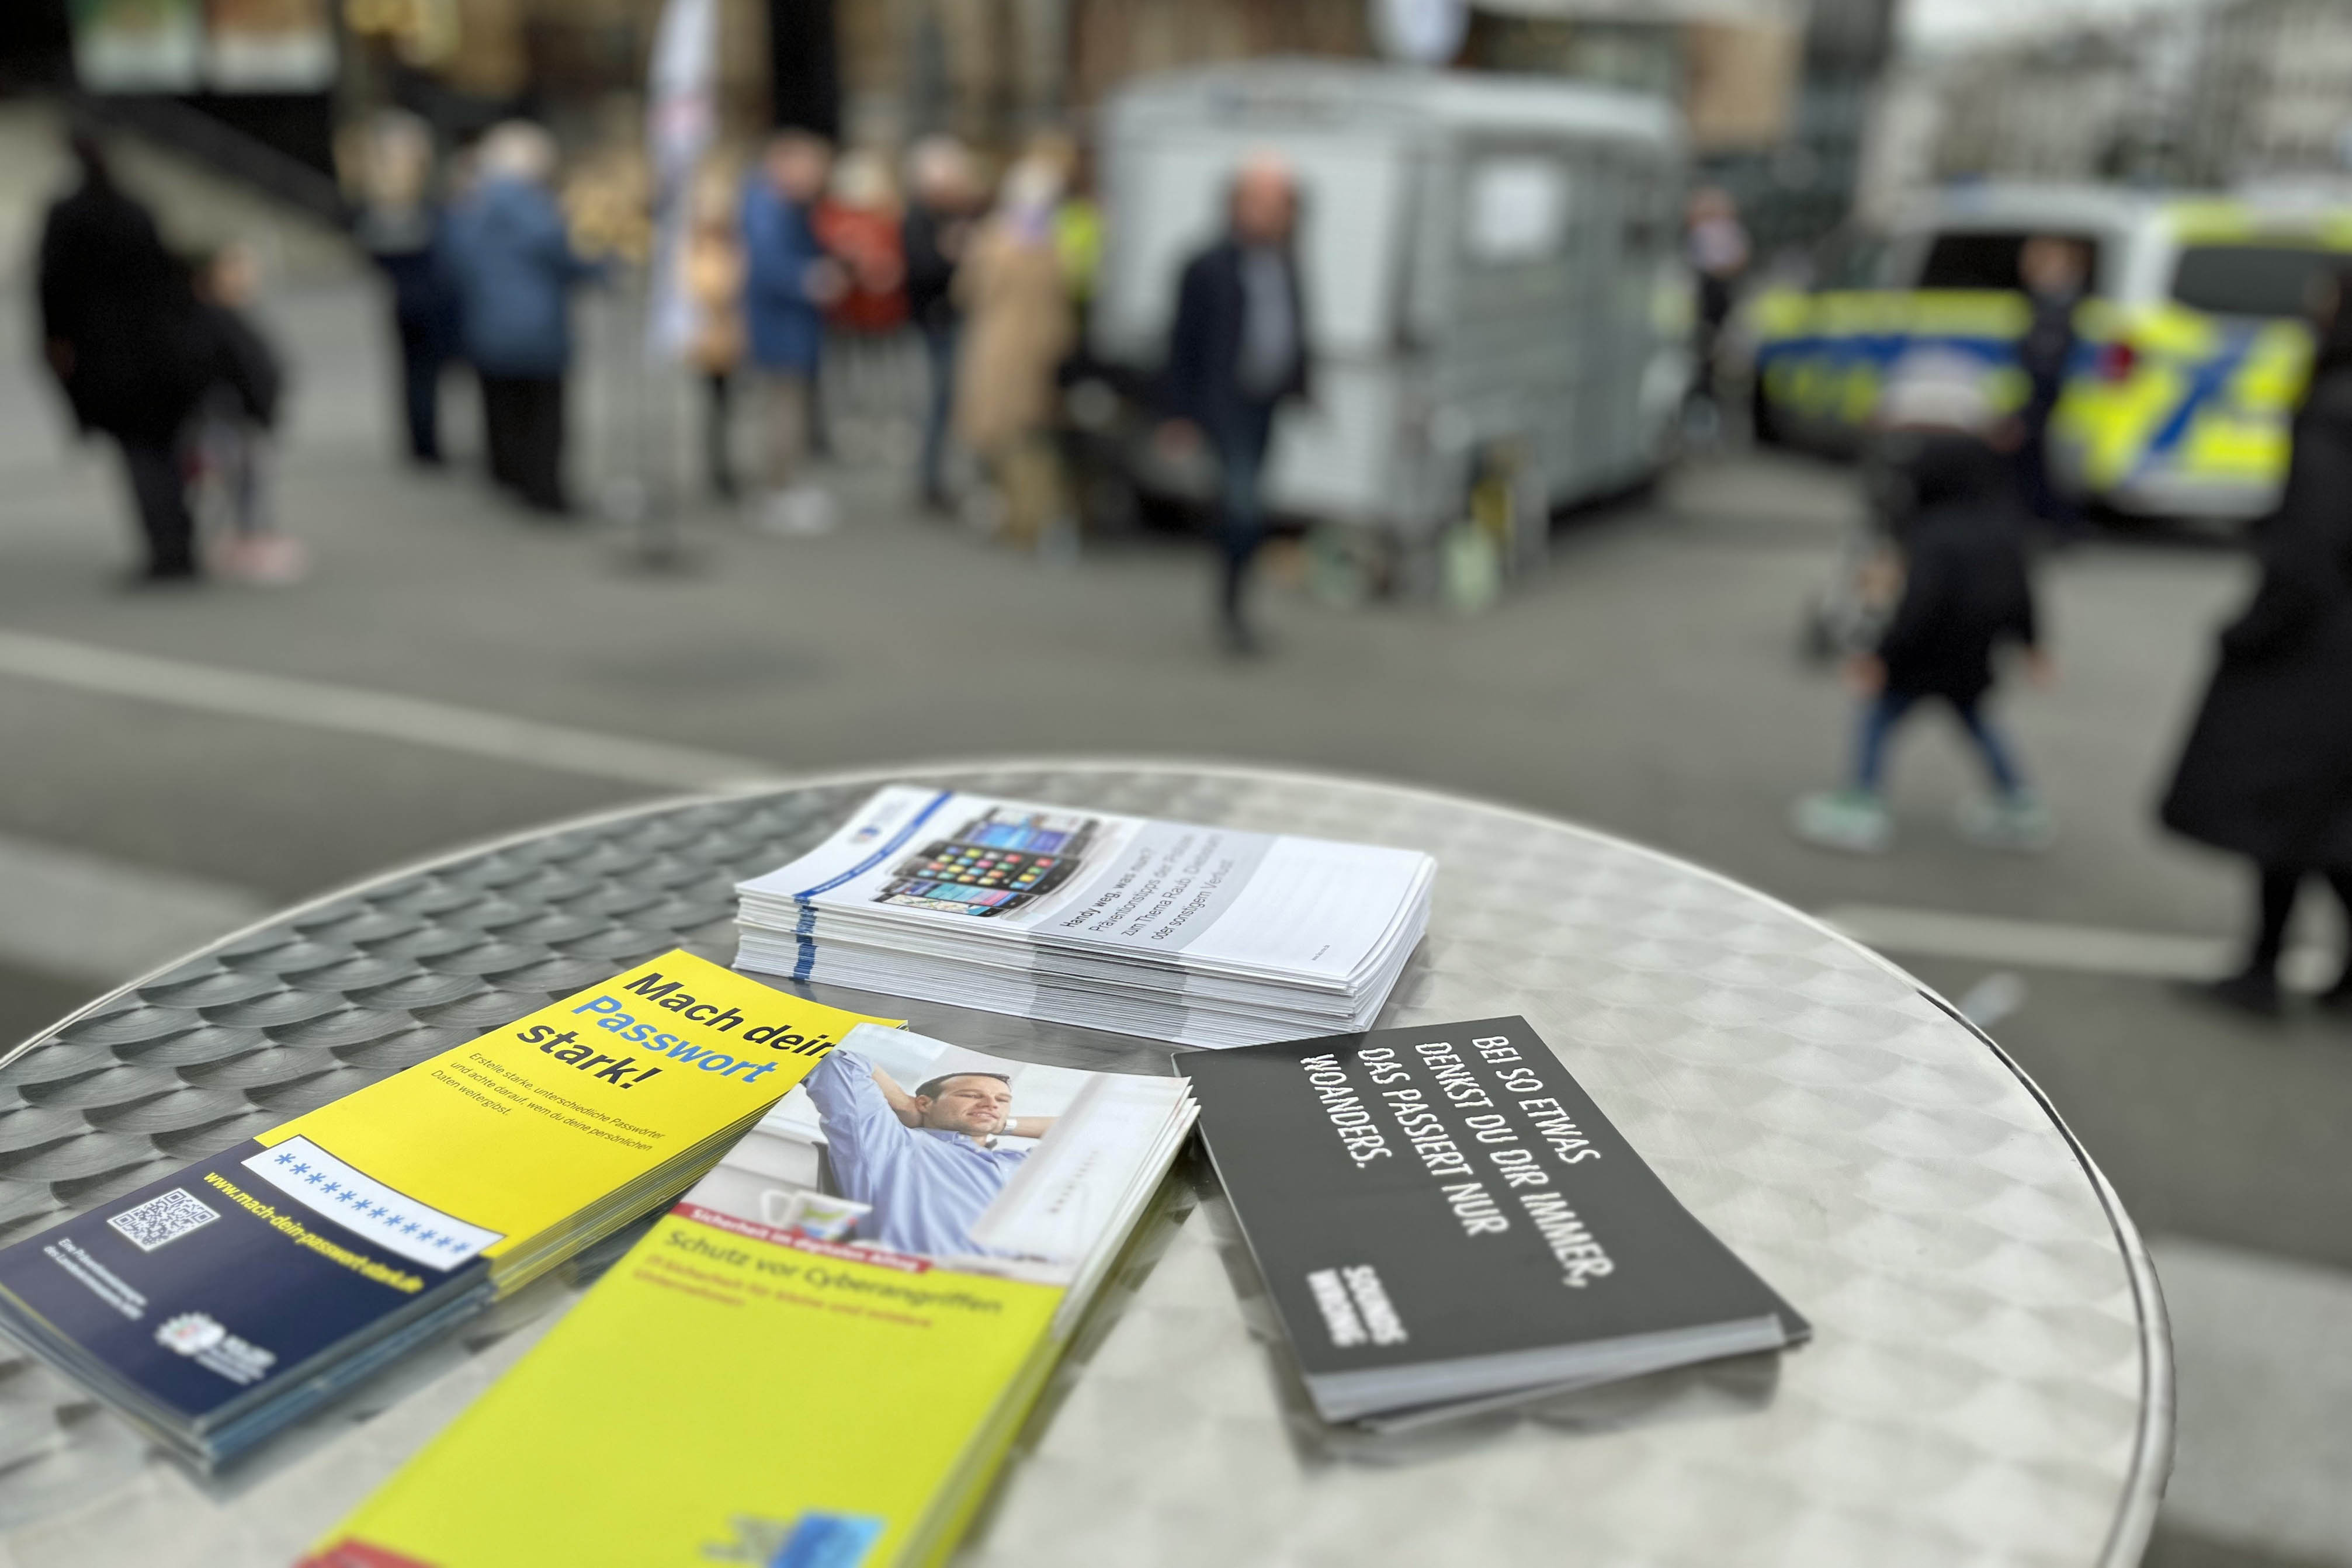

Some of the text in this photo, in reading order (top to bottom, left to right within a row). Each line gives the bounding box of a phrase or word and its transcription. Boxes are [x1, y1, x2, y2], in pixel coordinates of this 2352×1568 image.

[1060, 908, 1101, 928] Handy
[1092, 891, 1122, 908] weg,
[1113, 869, 1136, 890] was
[1088, 879, 1161, 932] Präventionstipps
[1121, 923, 1142, 936] zum
[1135, 900, 1172, 924] Thema
[1151, 927, 1175, 941] oder
[1169, 891, 1212, 927] sonstigem
[570, 995, 779, 1084] Passwort
[623, 972, 836, 1058] Mach dein
[431, 1070, 512, 1116] Daten weitergibst.
[469, 1053, 665, 1139] Erstelle starke, unterschiedliche Passwörter
[516, 1025, 664, 1090] stark!
[450, 1062, 653, 1151] und achte darauf, wem du deine persönlichen
[1300, 1053, 1392, 1168] WOANDERS.
[1358, 1047, 1510, 1237] DAS PASSIERT NUR
[1472, 1036, 1601, 1164] BEI SO ETWAS
[1415, 1042, 1614, 1288] DENKST DU DIR IMMER,
[691, 1208, 769, 1239] Sicherheit
[664, 1230, 1002, 1313] Schutz vor Cyberangriffen
